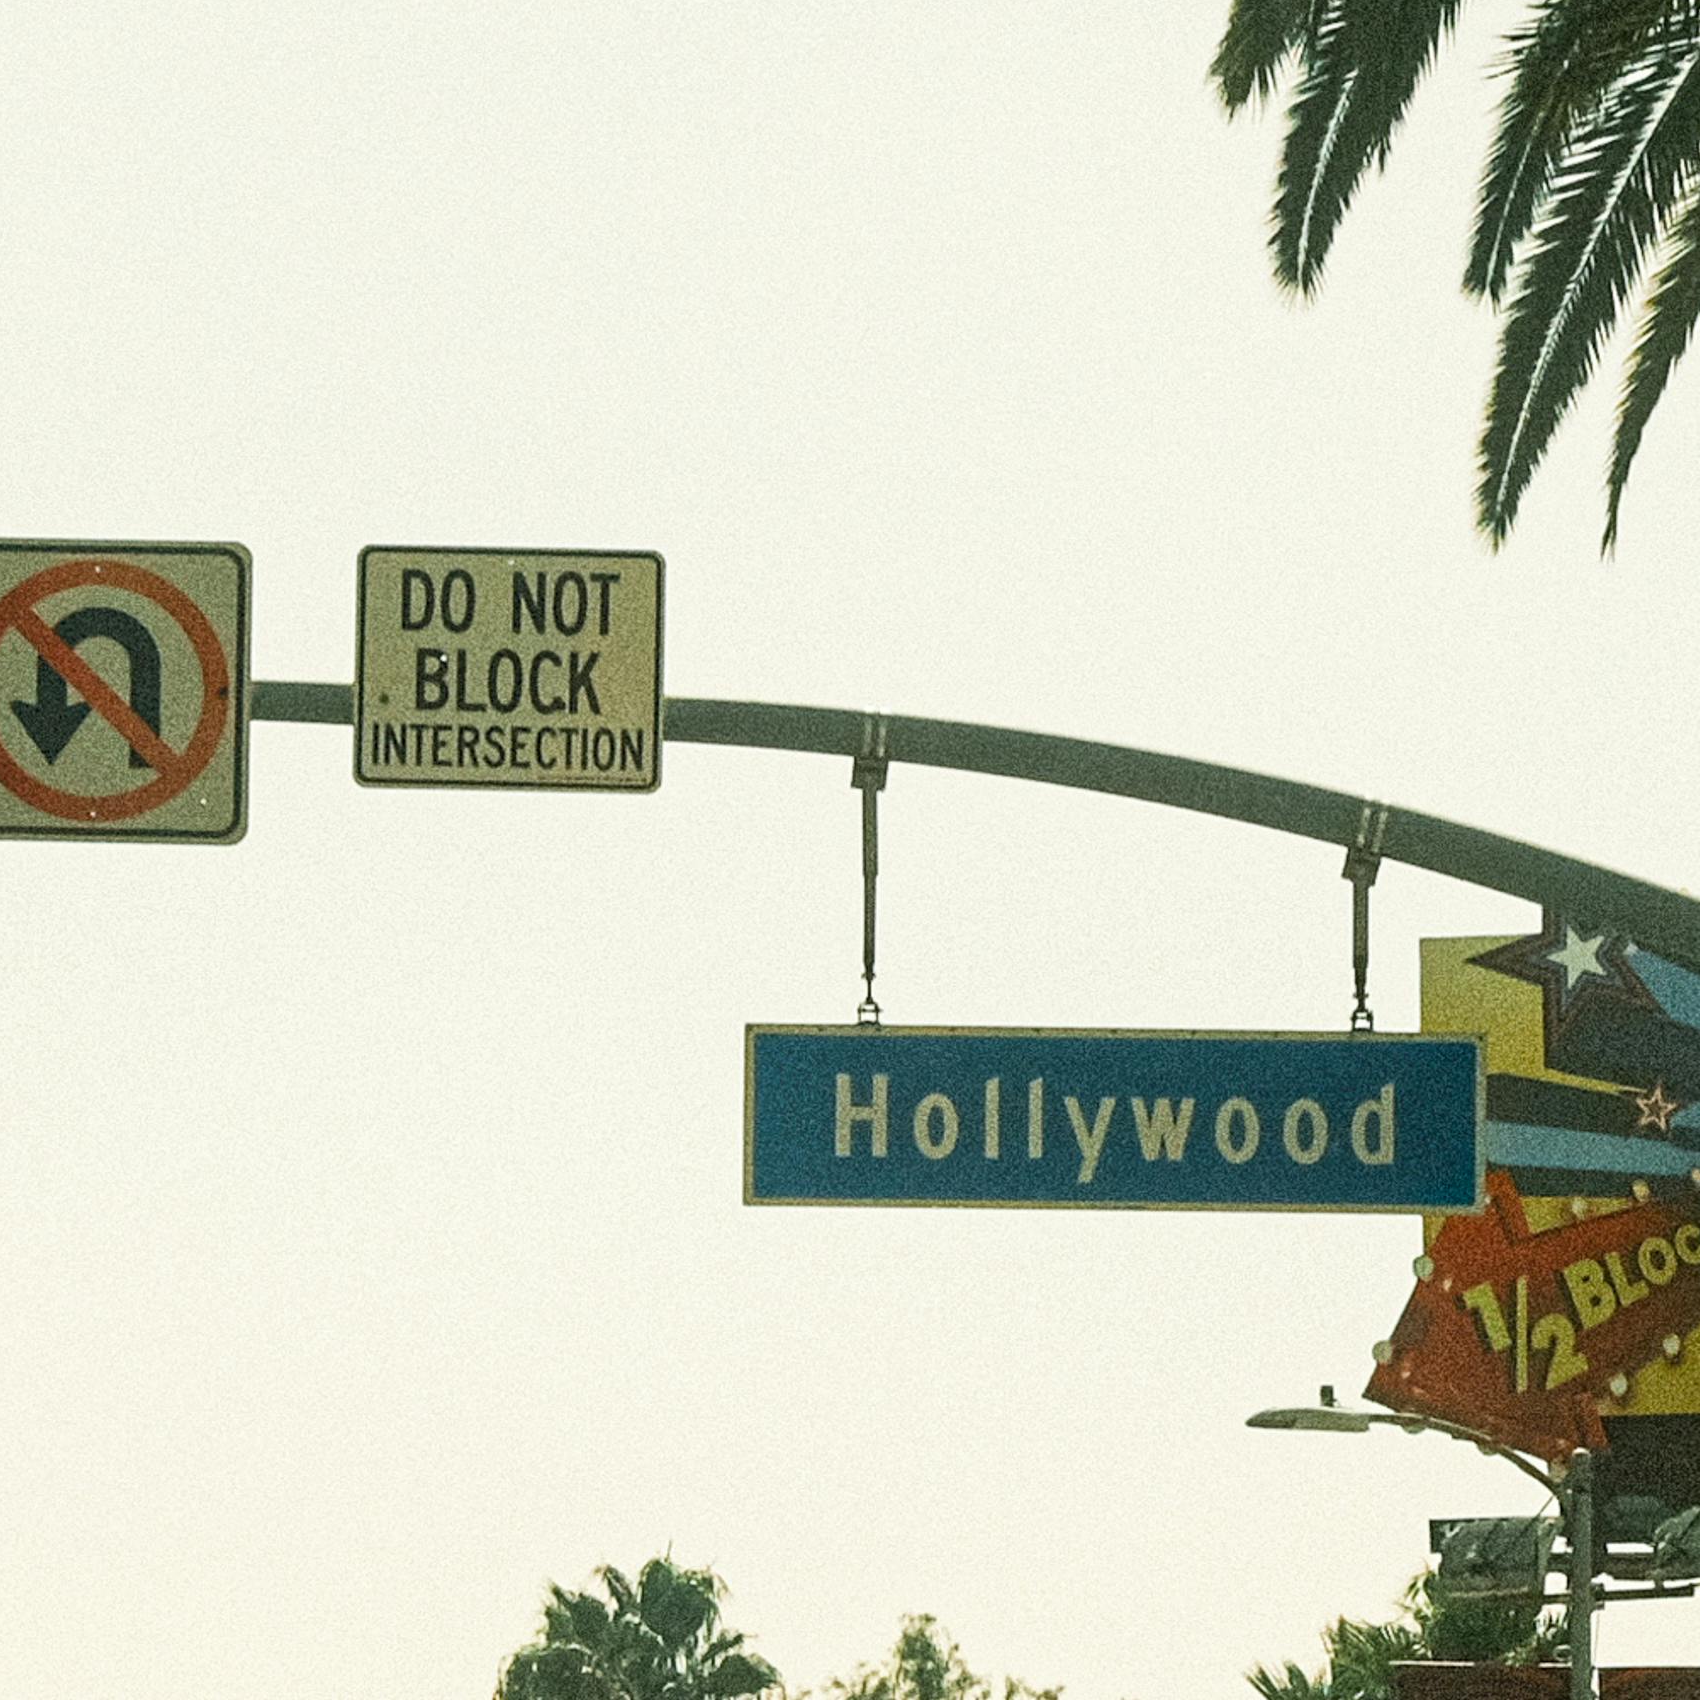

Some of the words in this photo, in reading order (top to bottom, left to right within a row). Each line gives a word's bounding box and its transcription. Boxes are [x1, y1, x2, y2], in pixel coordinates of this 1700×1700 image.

[401, 568, 476, 633] DO
[512, 570, 621, 636] NOT
[414, 648, 601, 715] BLOCK
[371, 721, 644, 772] INTERSECTION
[834, 1073, 1396, 1184] Hollywood
[1462, 1274, 1589, 1394] 1/2
